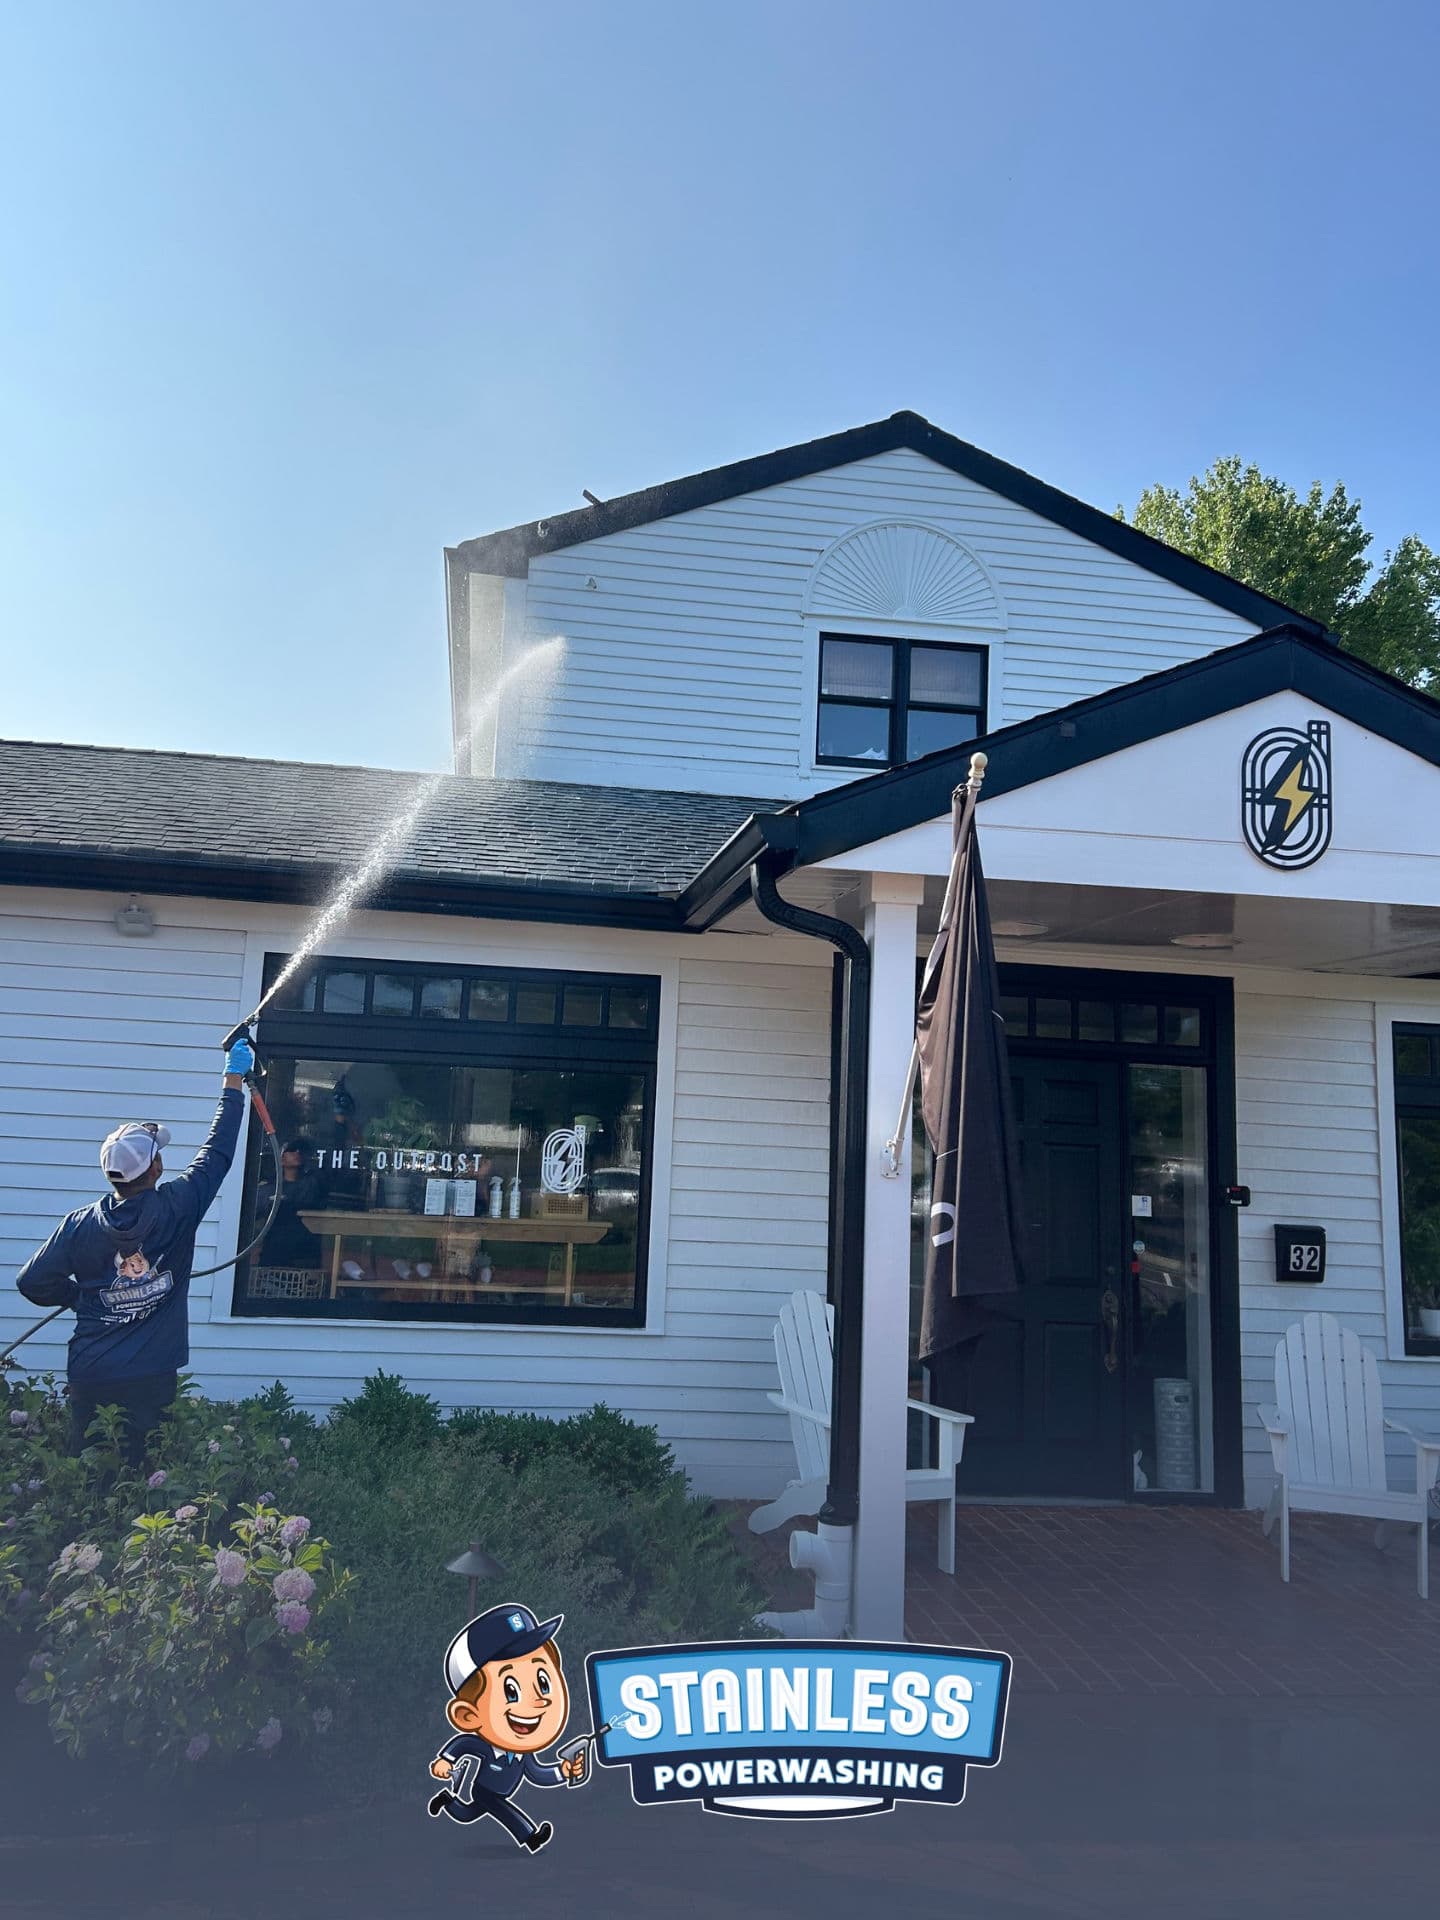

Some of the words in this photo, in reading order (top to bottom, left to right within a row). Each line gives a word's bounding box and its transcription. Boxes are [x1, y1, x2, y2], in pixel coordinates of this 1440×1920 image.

[317, 1150, 359, 1169] THE
[376, 1151, 482, 1172] OUTPOST
[1292, 1246, 1318, 1270] 32
[106, 1277, 168, 1303] STAINLESS
